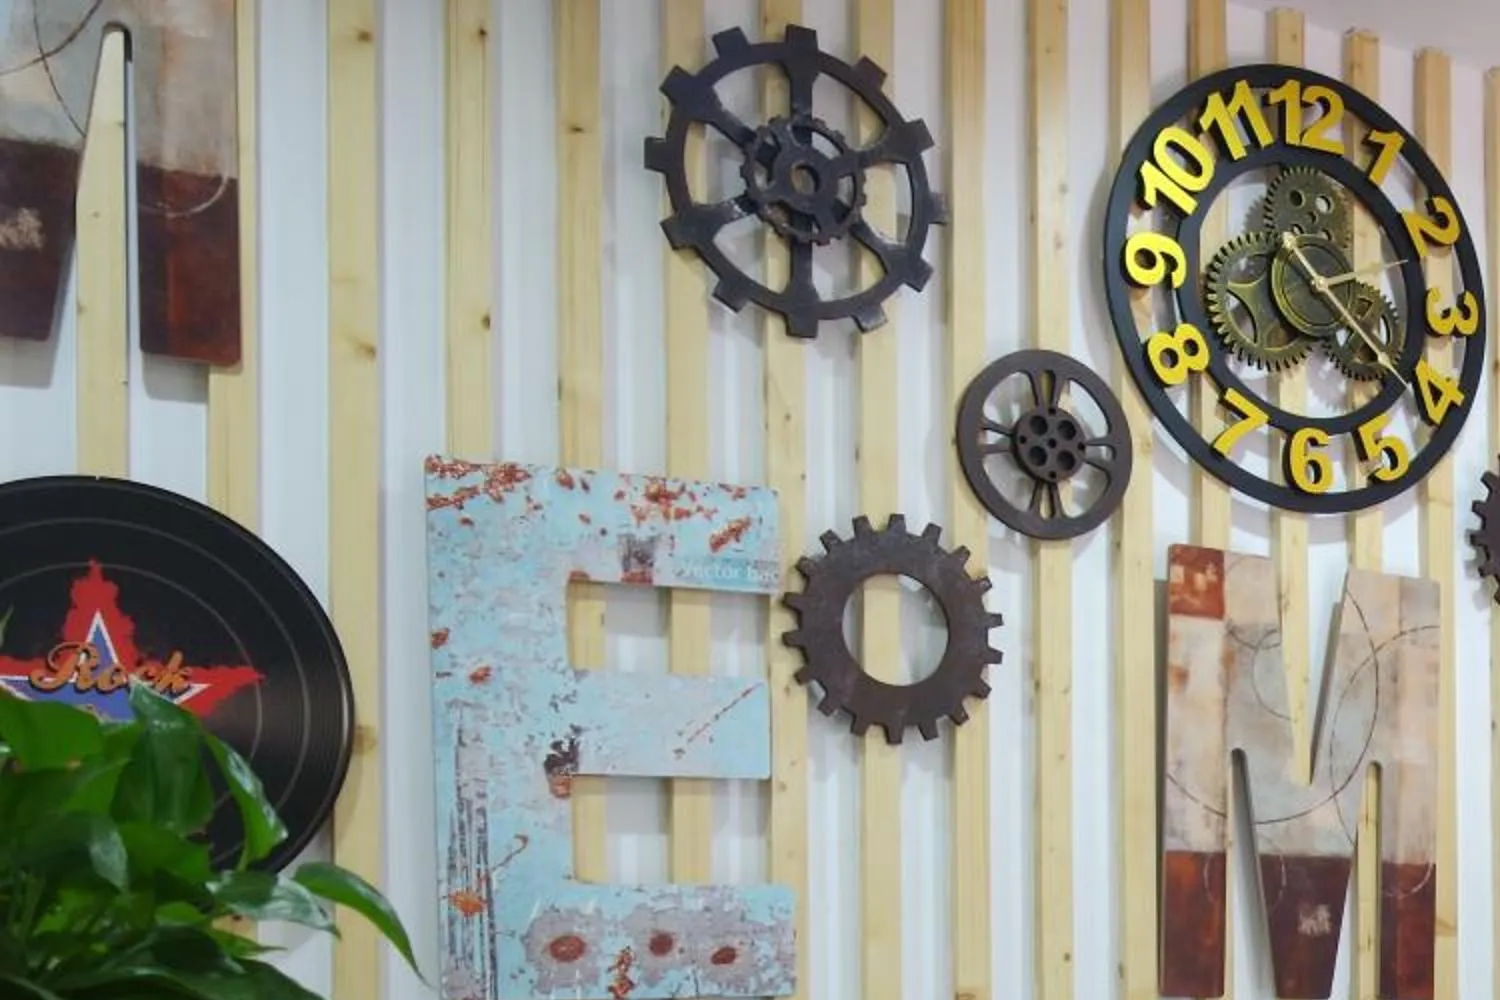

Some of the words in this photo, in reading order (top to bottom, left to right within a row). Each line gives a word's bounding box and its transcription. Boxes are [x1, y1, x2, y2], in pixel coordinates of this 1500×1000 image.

[1200, 81, 1275, 160] 11
[1269, 80, 1346, 155] 12
[1140, 127, 1214, 215] 10
[1369, 129, 1406, 184] 1
[1402, 196, 1460, 256] 2
[1125, 232, 1186, 288] 9
[1426, 288, 1478, 337] 3
[1148, 324, 1209, 385] 8
[1214, 389, 1271, 456] 7
[1415, 360, 1464, 425] 4
[1290, 428, 1333, 494] 6
[1359, 416, 1409, 480] 5
[29, 640, 193, 692] Rock
